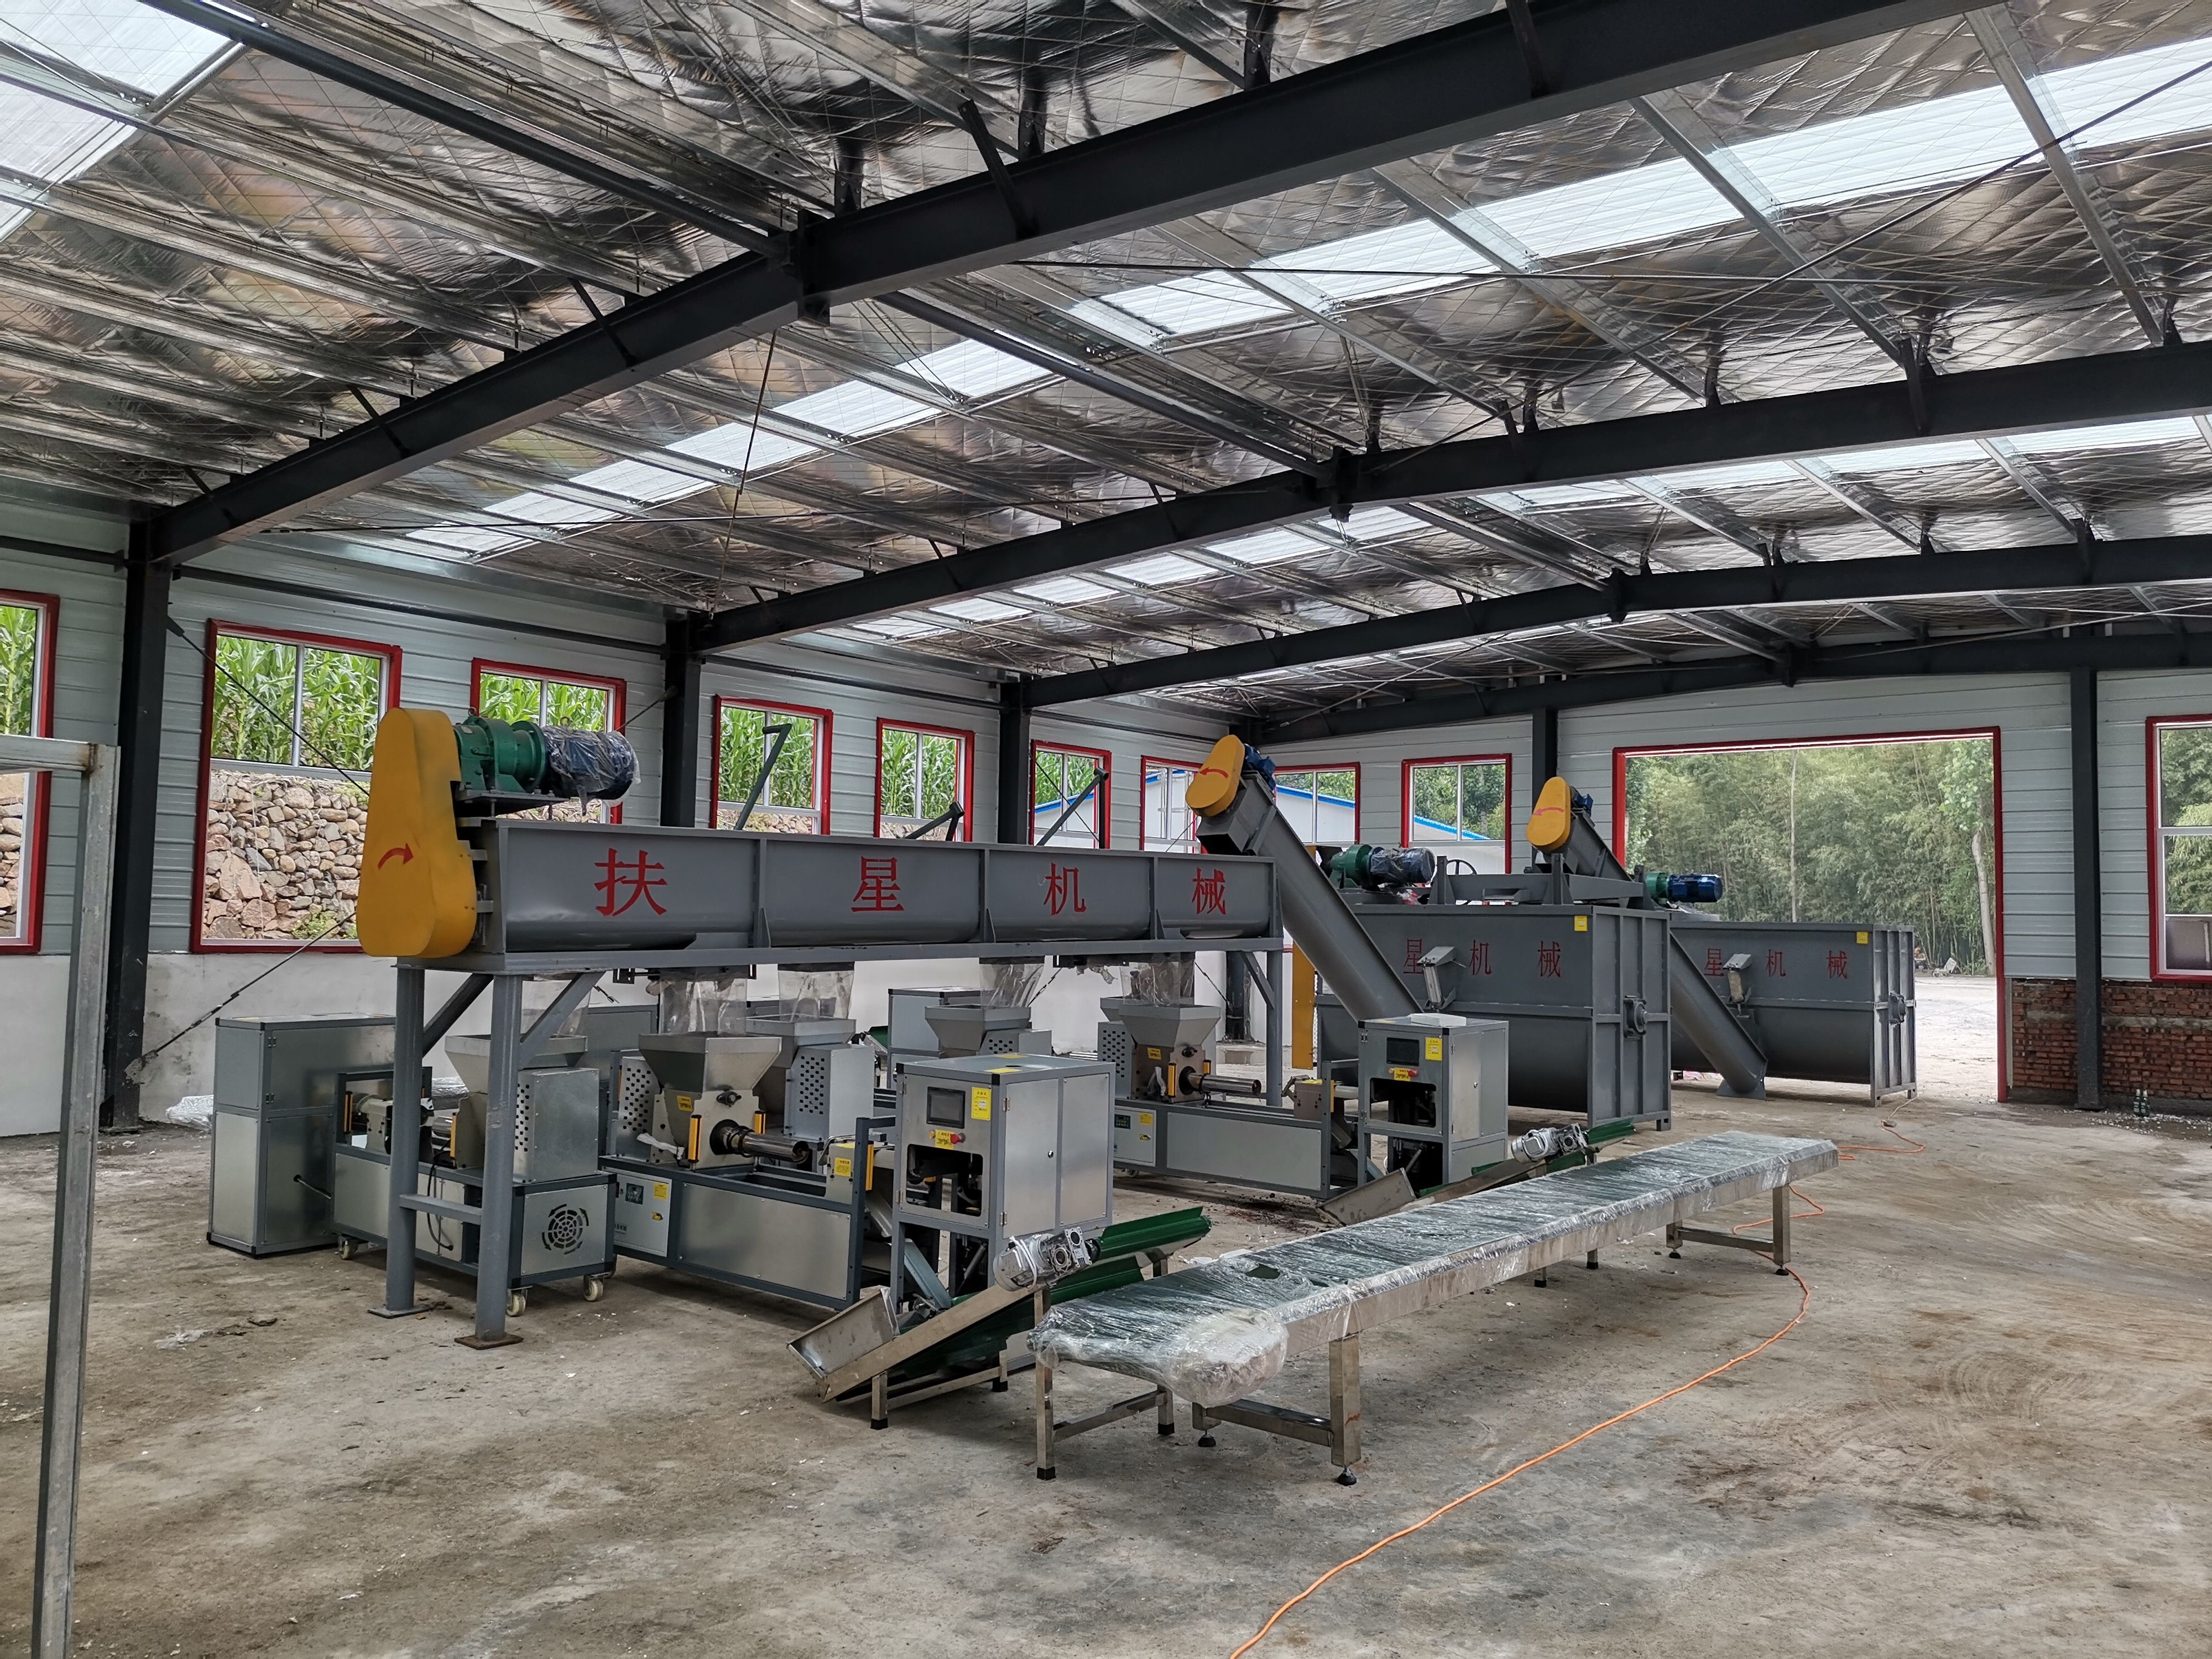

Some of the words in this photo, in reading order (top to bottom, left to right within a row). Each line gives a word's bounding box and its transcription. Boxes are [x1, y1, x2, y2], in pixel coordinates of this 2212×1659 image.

[594, 848, 1225, 916] 扶星机械
[1403, 938, 1561, 978] 星机械
[1704, 948, 1848, 979] 星机械
